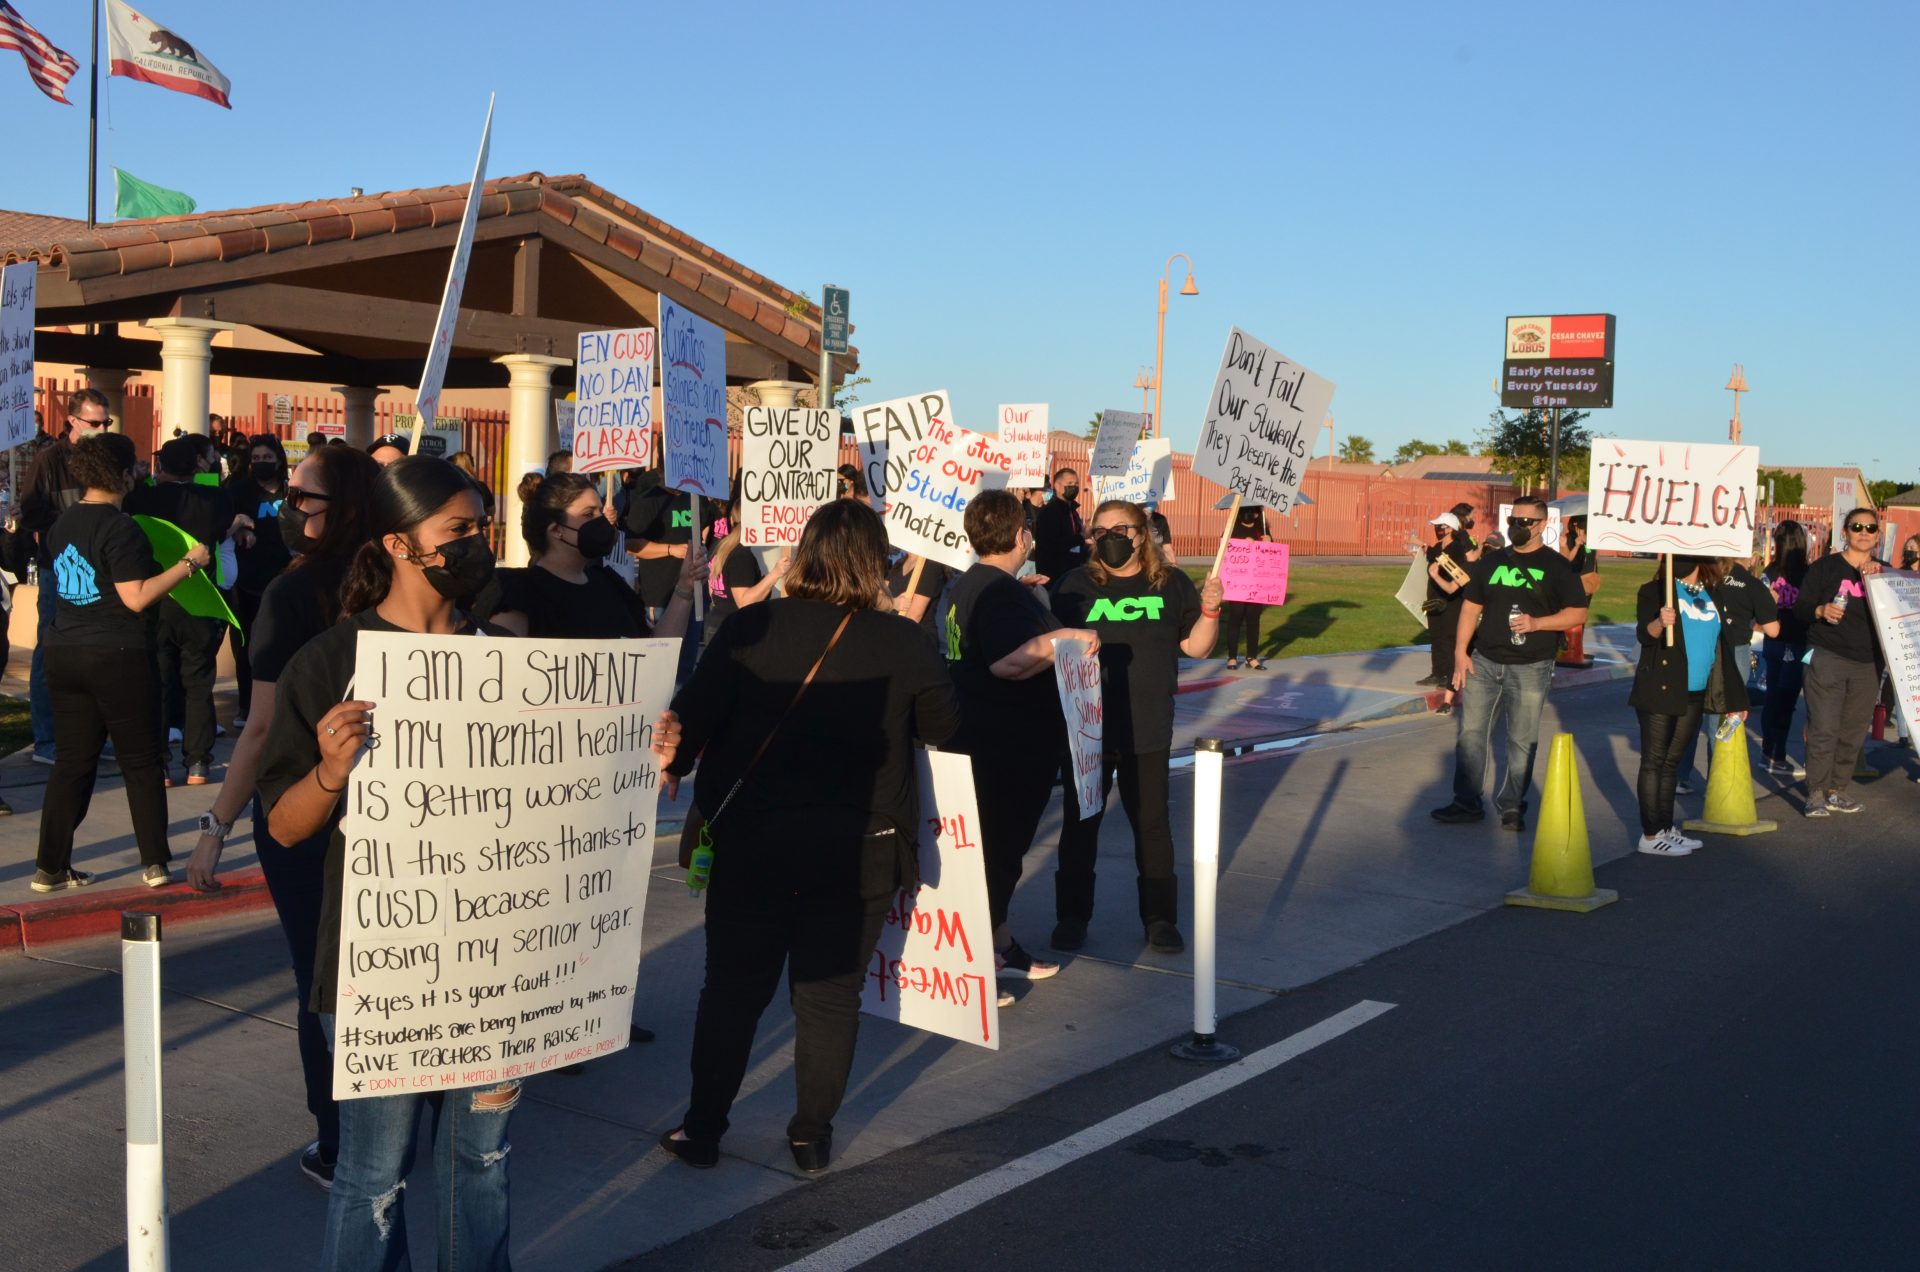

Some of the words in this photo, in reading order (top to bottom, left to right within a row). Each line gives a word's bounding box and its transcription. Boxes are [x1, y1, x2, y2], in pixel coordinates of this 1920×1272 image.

[134, 56, 173, 72] CALIFORNIA
[178, 66, 212, 82] REPUBLIC
[20, 276, 33, 311] get
[13, 327, 31, 352] show
[580, 333, 611, 365] EN
[613, 332, 655, 362] CUSD
[1511, 341, 1545, 353] LOBOS
[1551, 332, 1575, 340] CESAR
[1576, 331, 1605, 340] CHAVEZ
[11, 361, 20, 381] the
[1227, 332, 1267, 387] Don't
[1509, 366, 1542, 378] Early
[1544, 366, 1596, 376] Release
[579, 373, 605, 400] NO
[611, 364, 649, 394] DAN
[1507, 381, 1543, 392] Every
[1544, 381, 1598, 392] Tuesday
[577, 395, 650, 427] CUENTAS
[703, 379, 721, 418] aún
[1532, 396, 1567, 407] @1pm
[449, 418, 459, 431] BY
[747, 406, 800, 437] GIVE
[805, 409, 830, 441] US
[927, 416, 953, 445] The
[1004, 406, 1033, 424] Our
[1218, 379, 1249, 421] Our
[1250, 403, 1305, 458] Students
[575, 428, 649, 459] CLARAS
[683, 415, 711, 448] tienen
[1003, 427, 1047, 444] Students
[769, 439, 813, 469] OUR
[1206, 420, 1232, 466] They
[1239, 434, 1280, 476] Deserve
[1280, 456, 1297, 487] the
[743, 468, 836, 502] CONTRACT
[942, 460, 985, 486] our
[1130, 467, 1152, 485] not
[1229, 466, 1252, 497] Best
[1252, 477, 1289, 513] Teachers
[1593, 463, 1755, 531] HUELGA
[745, 527, 758, 544] IS
[1086, 596, 1165, 623] ACT
[382, 651, 387, 698] I
[406, 649, 462, 702] am
[478, 650, 503, 703] a
[1059, 652, 1077, 694] WE
[394, 719, 444, 769] my
[467, 719, 563, 768] mental
[577, 713, 652, 759] health
[404, 780, 511, 829] getting
[526, 774, 602, 809] worse
[613, 763, 657, 796] with
[351, 838, 394, 878] all
[407, 839, 466, 876] this
[477, 838, 550, 873] stress
[553, 824, 620, 861] thanks
[622, 811, 646, 848] to
[928, 814, 975, 849] The
[357, 888, 438, 929] CUSD
[454, 886, 550, 923] because
[565, 874, 570, 903] I
[578, 868, 612, 901] am
[350, 941, 440, 984] loosing
[457, 938, 498, 968] my
[513, 921, 581, 953] senior
[469, 983, 507, 1008] your
[449, 1020, 477, 1040] are
[480, 1014, 516, 1036] being
[520, 1000, 565, 1026] harmed
[569, 996, 584, 1010] by
[586, 988, 607, 1008] this
[346, 1052, 399, 1075] GIVE
